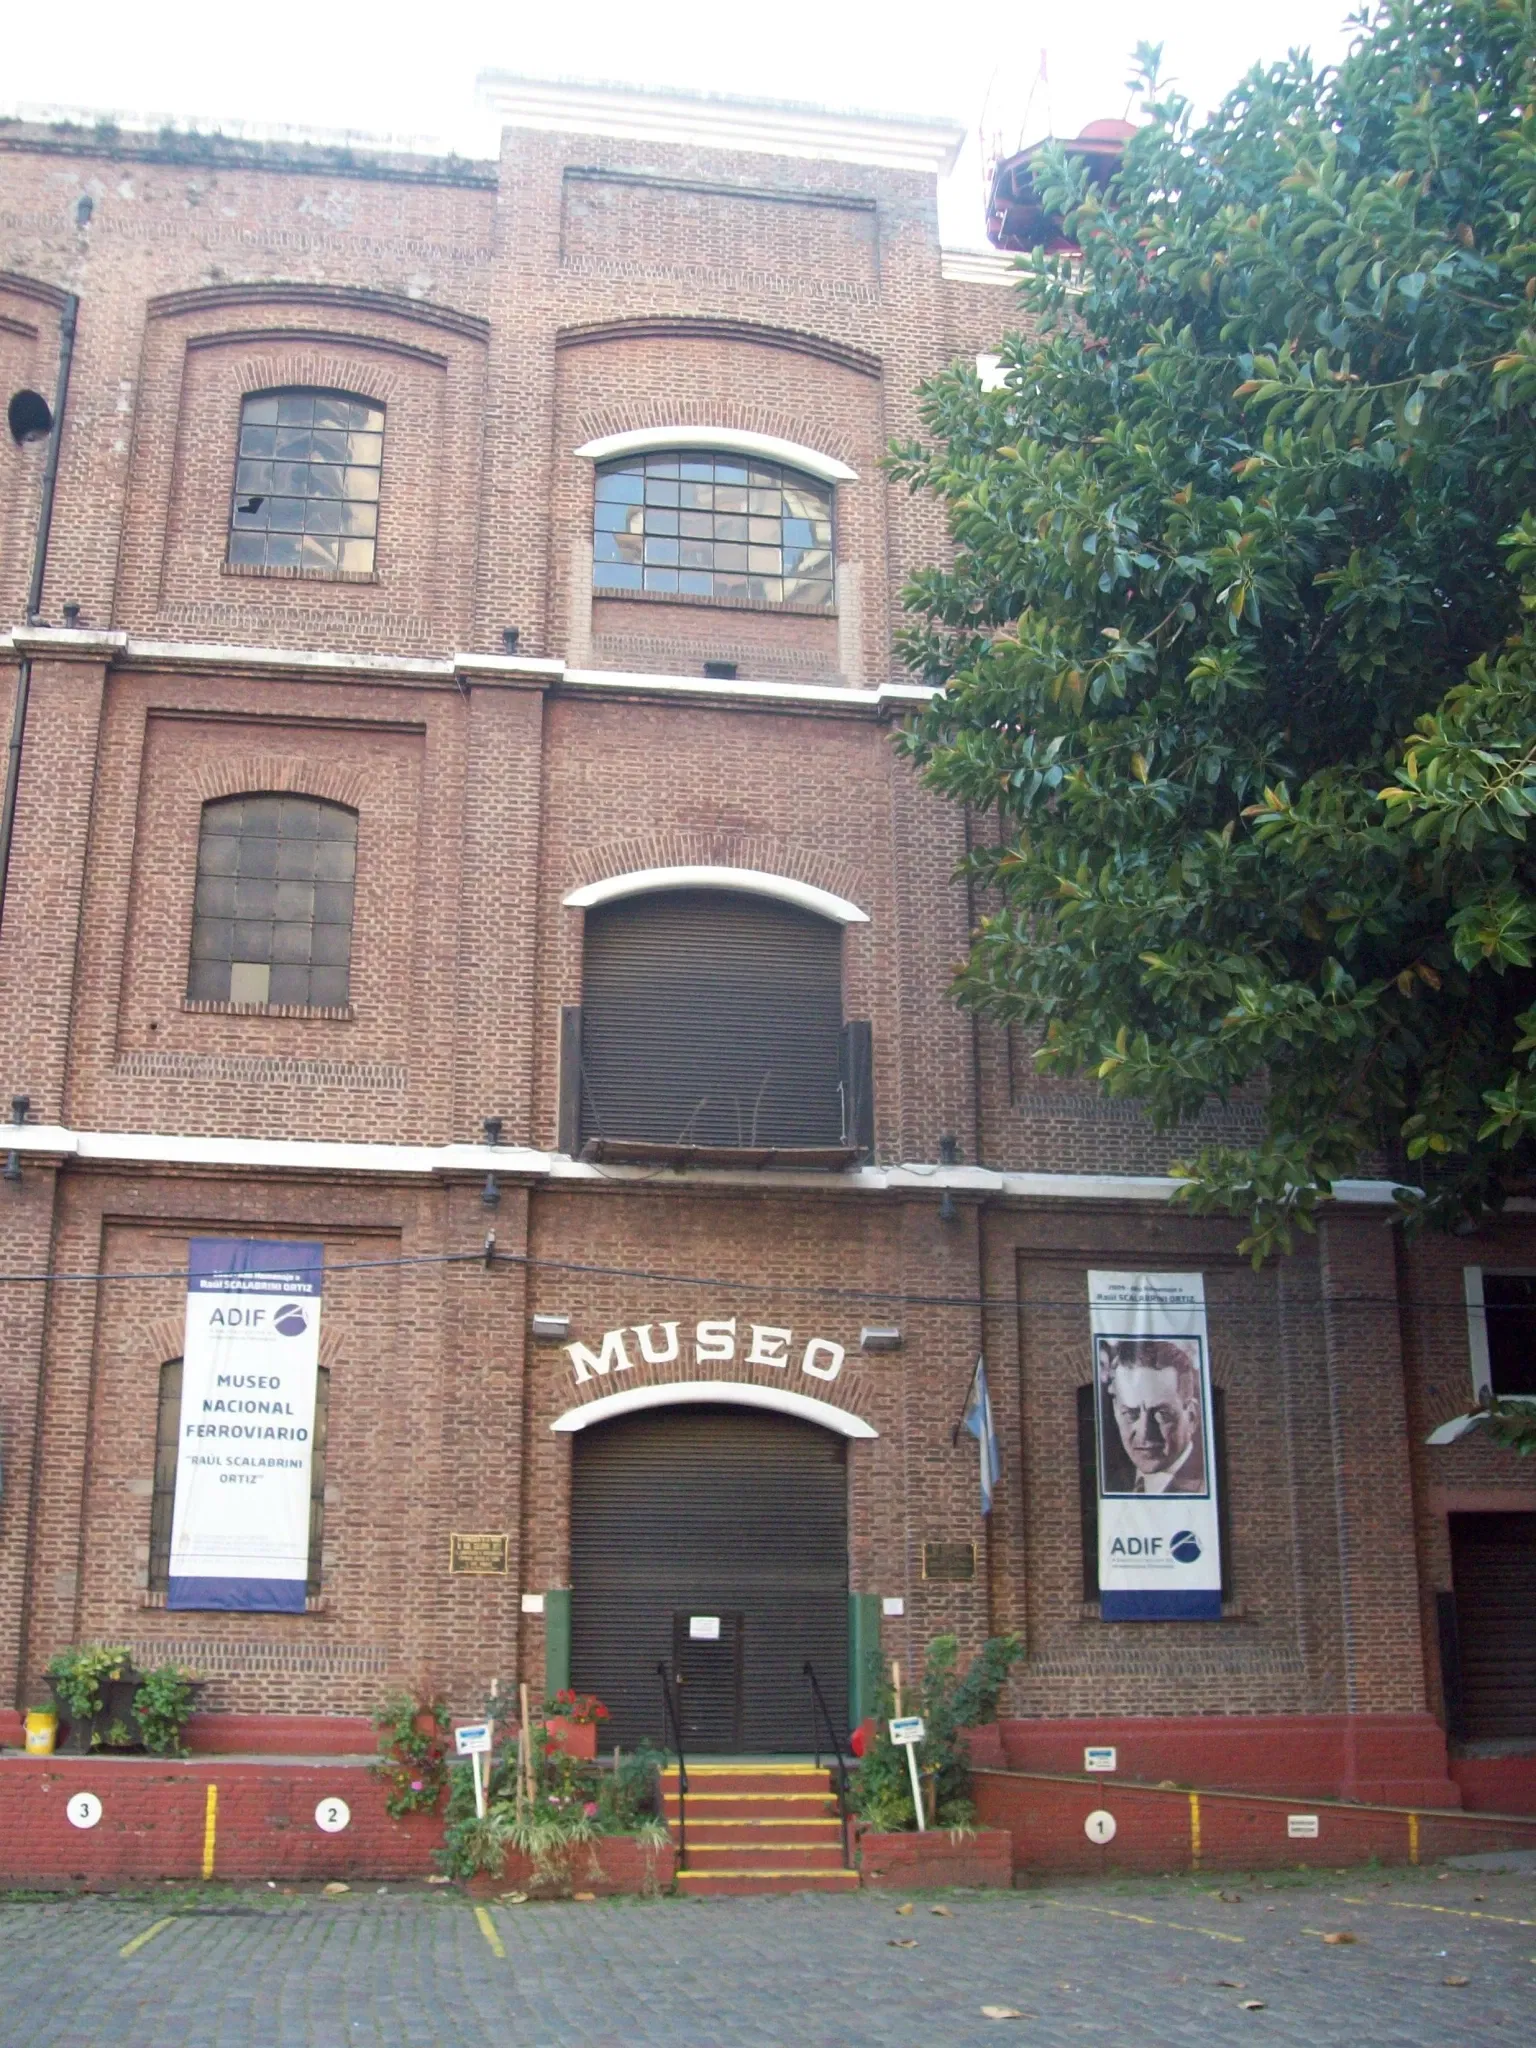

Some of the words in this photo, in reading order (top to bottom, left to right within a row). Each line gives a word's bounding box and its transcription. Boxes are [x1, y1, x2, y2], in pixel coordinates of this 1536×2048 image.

[283, 1283, 313, 1293] ORTIZ
[209, 1307, 266, 1327] ADIF
[563, 1316, 845, 1385] MUSEO
[217, 1374, 281, 1390] MUSEO
[202, 1399, 295, 1416] NACIONAL
[185, 1424, 308, 1442] FERROVIARIO
[225, 1456, 303, 1469] SCALABRINI
[1111, 1537, 1163, 1555] ADIF
[80, 1803, 89, 1818] 3
[328, 1808, 337, 1822] 2
